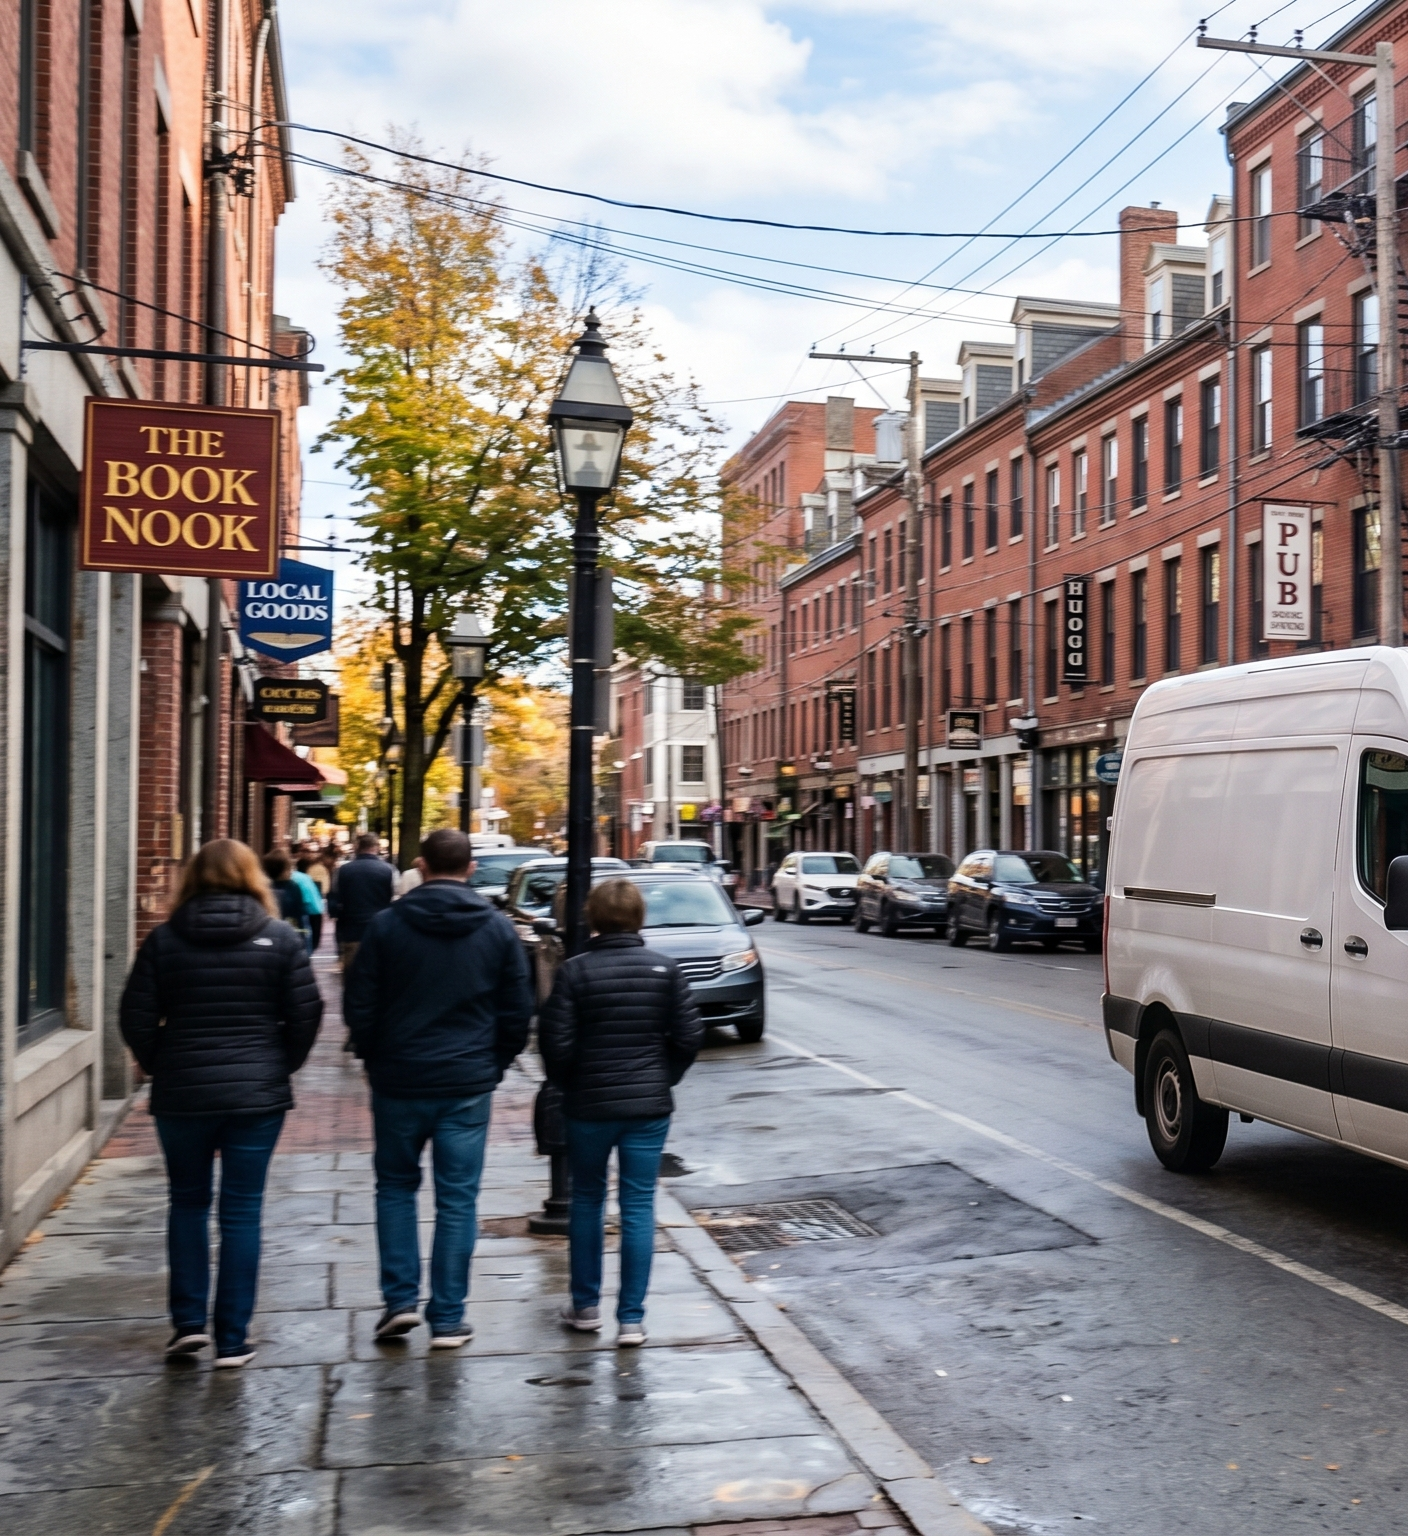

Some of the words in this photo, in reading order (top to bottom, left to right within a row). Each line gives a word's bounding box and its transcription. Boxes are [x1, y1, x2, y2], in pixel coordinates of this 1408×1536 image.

[139, 426, 225, 458] THE
[103, 460, 259, 506] BOOK
[101, 506, 260, 552] NOOK
[1276, 522, 1300, 606] PUB
[246, 582, 328, 601] LOCAL
[244, 602, 328, 621] GOODS
